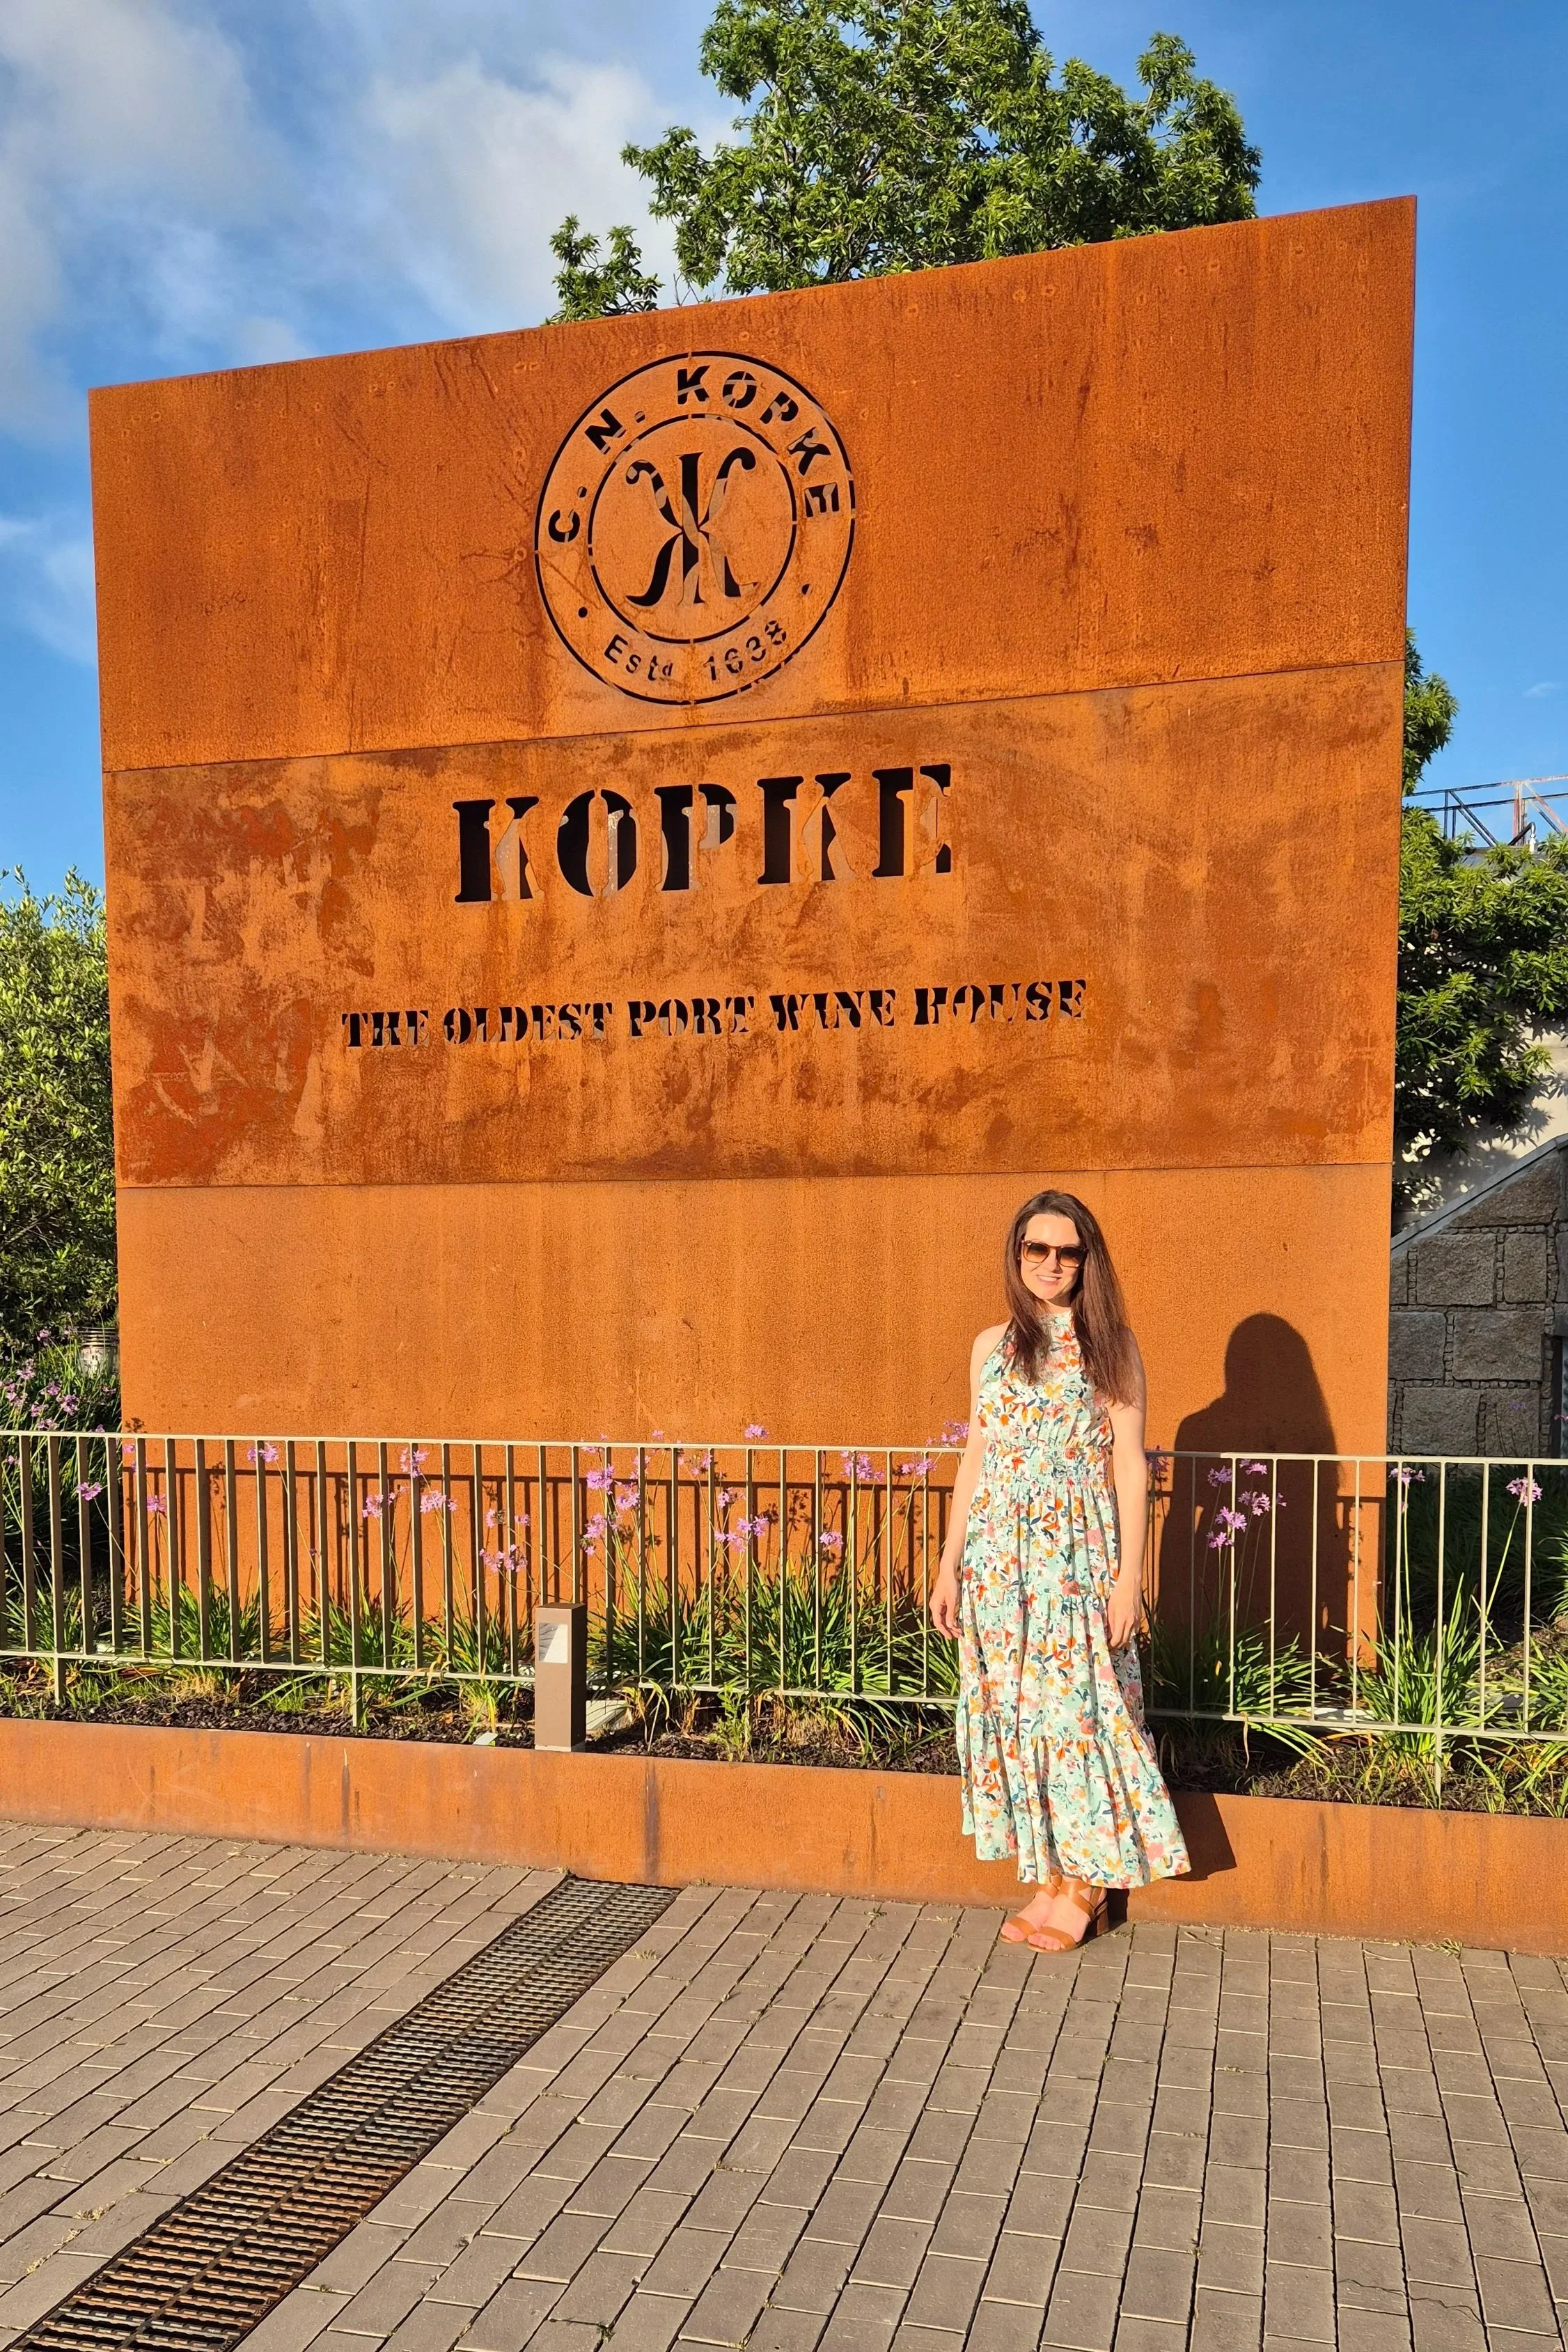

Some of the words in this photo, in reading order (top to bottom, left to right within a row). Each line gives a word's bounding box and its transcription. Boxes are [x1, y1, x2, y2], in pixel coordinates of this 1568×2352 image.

[676, 364, 840, 518] KOPKE
[703, 620, 787, 681] 1638
[451, 762, 952, 903] KOPKE
[341, 1009, 429, 1047] THE
[443, 1001, 613, 1044] OLDEST
[627, 996, 755, 1038] PORT
[768, 989, 896, 1031] WINE
[913, 978, 1088, 1026] HOUSE
